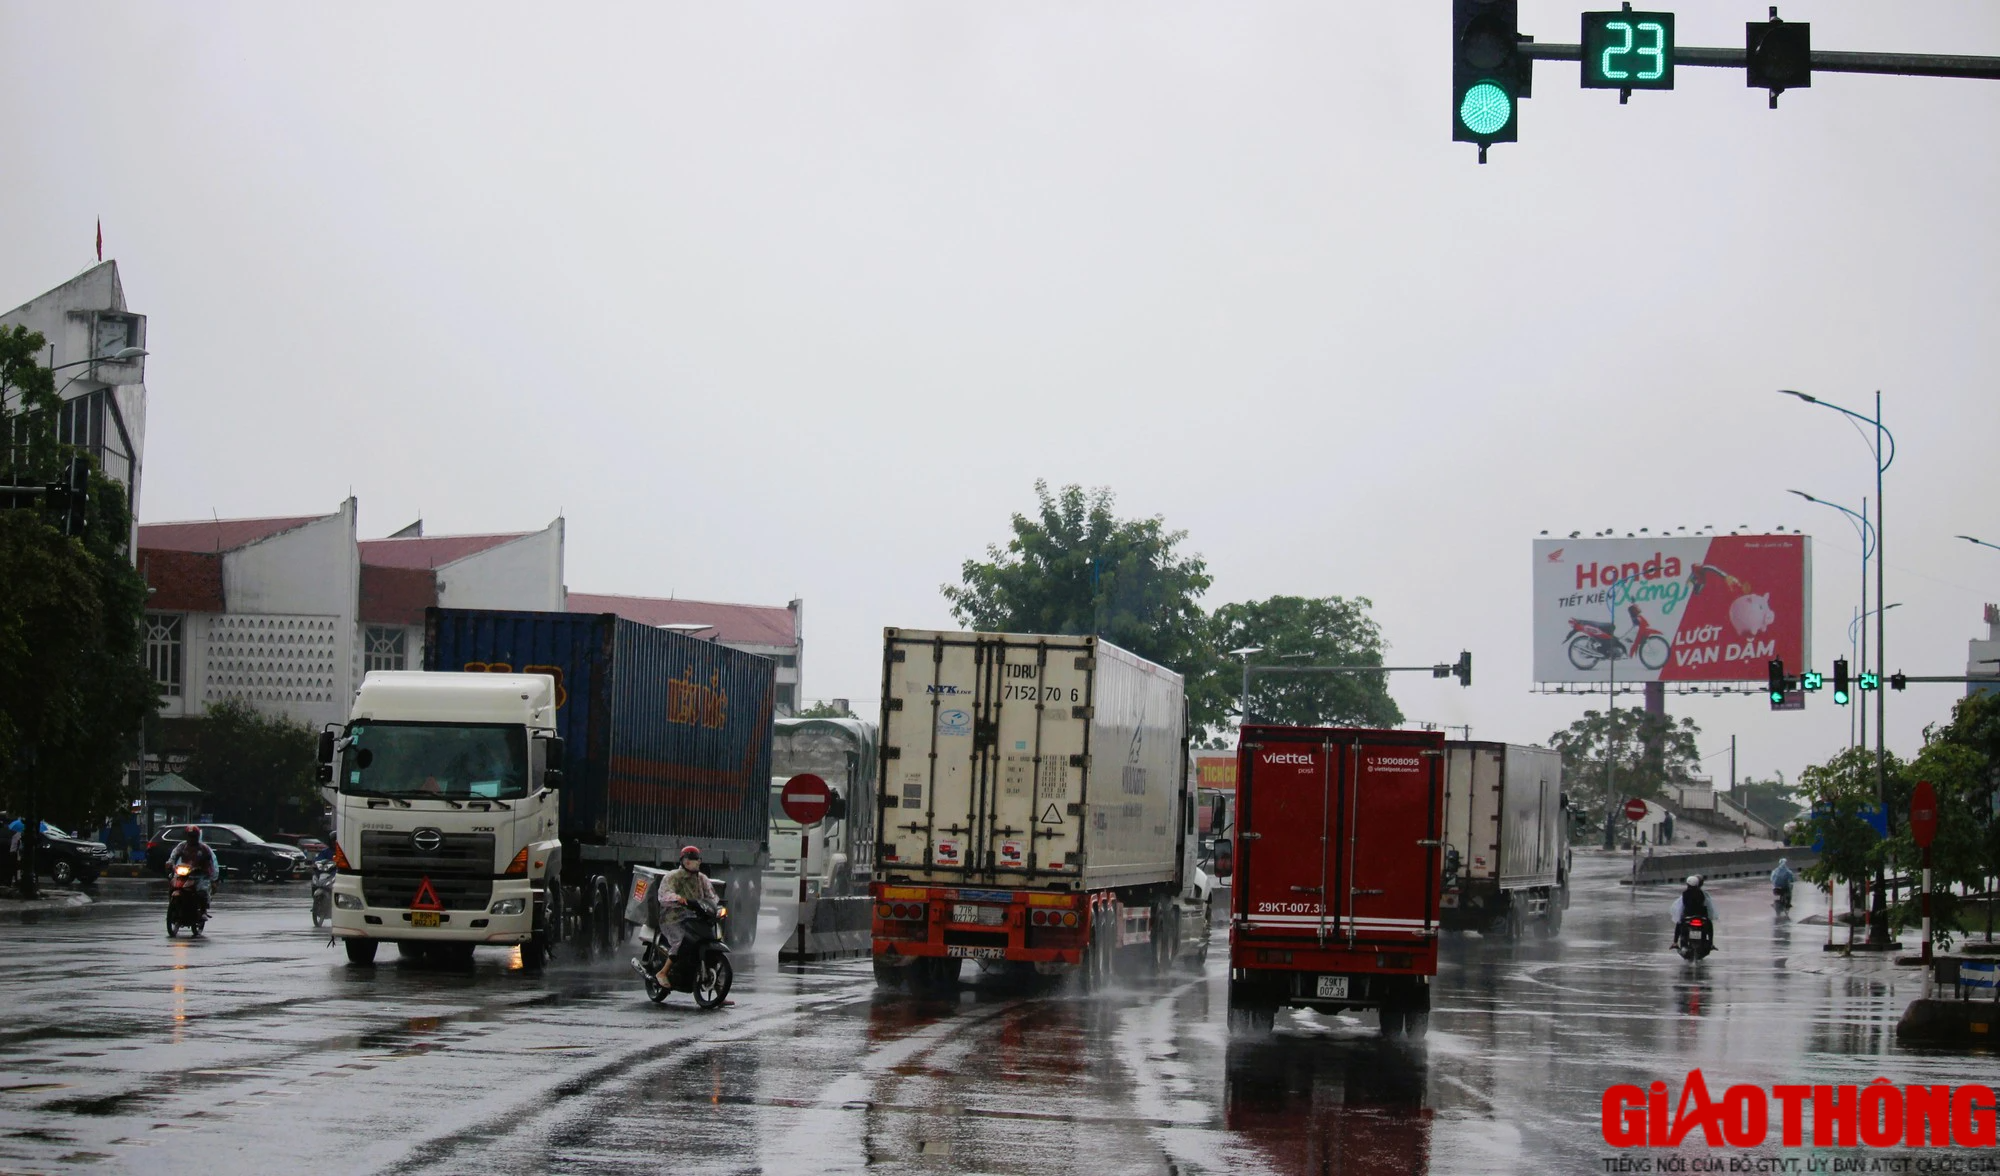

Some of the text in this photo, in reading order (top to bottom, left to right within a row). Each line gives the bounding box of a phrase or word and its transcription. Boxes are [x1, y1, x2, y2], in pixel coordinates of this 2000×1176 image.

[1602, 22, 1664, 79] 23
[1576, 552, 1681, 590] Honda
[1558, 592, 1583, 608] TIẾT
[1614, 579, 1689, 614] Xăng
[1675, 624, 1722, 645] LƯỚT
[1675, 637, 1775, 670] VẠN DẶM
[1006, 664, 1036, 679] TDRU
[1804, 672, 1821, 689] 24
[1860, 673, 1878, 689] 24
[1004, 685, 1079, 702] 7152 70 6
[1263, 753, 1314, 764] viettel
[1377, 757, 1419, 766] 19008095
[1324, 977, 1342, 987] 29KT
[1320, 986, 1344, 996] 007.38
